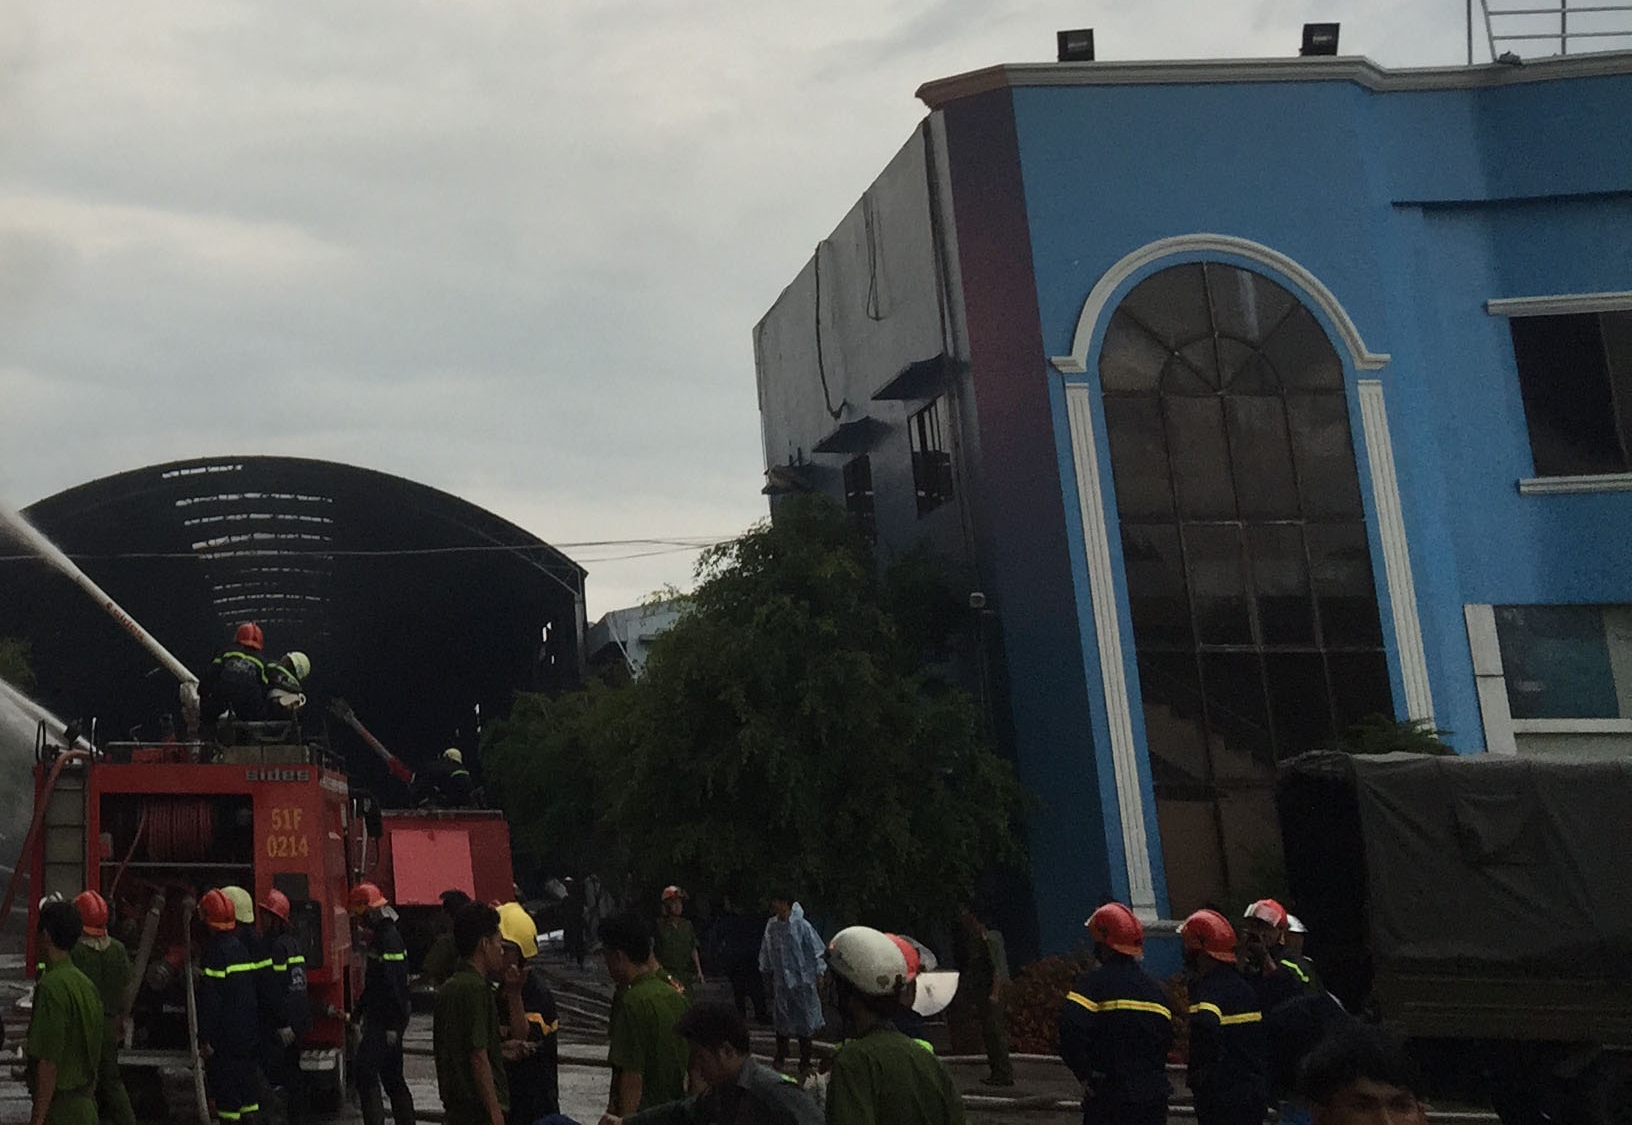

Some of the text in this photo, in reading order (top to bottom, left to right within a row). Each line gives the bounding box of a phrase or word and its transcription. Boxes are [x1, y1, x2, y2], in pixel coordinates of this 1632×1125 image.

[246, 768, 309, 781] sides
[271, 808, 302, 830] 51F
[267, 835, 308, 857] 0214
